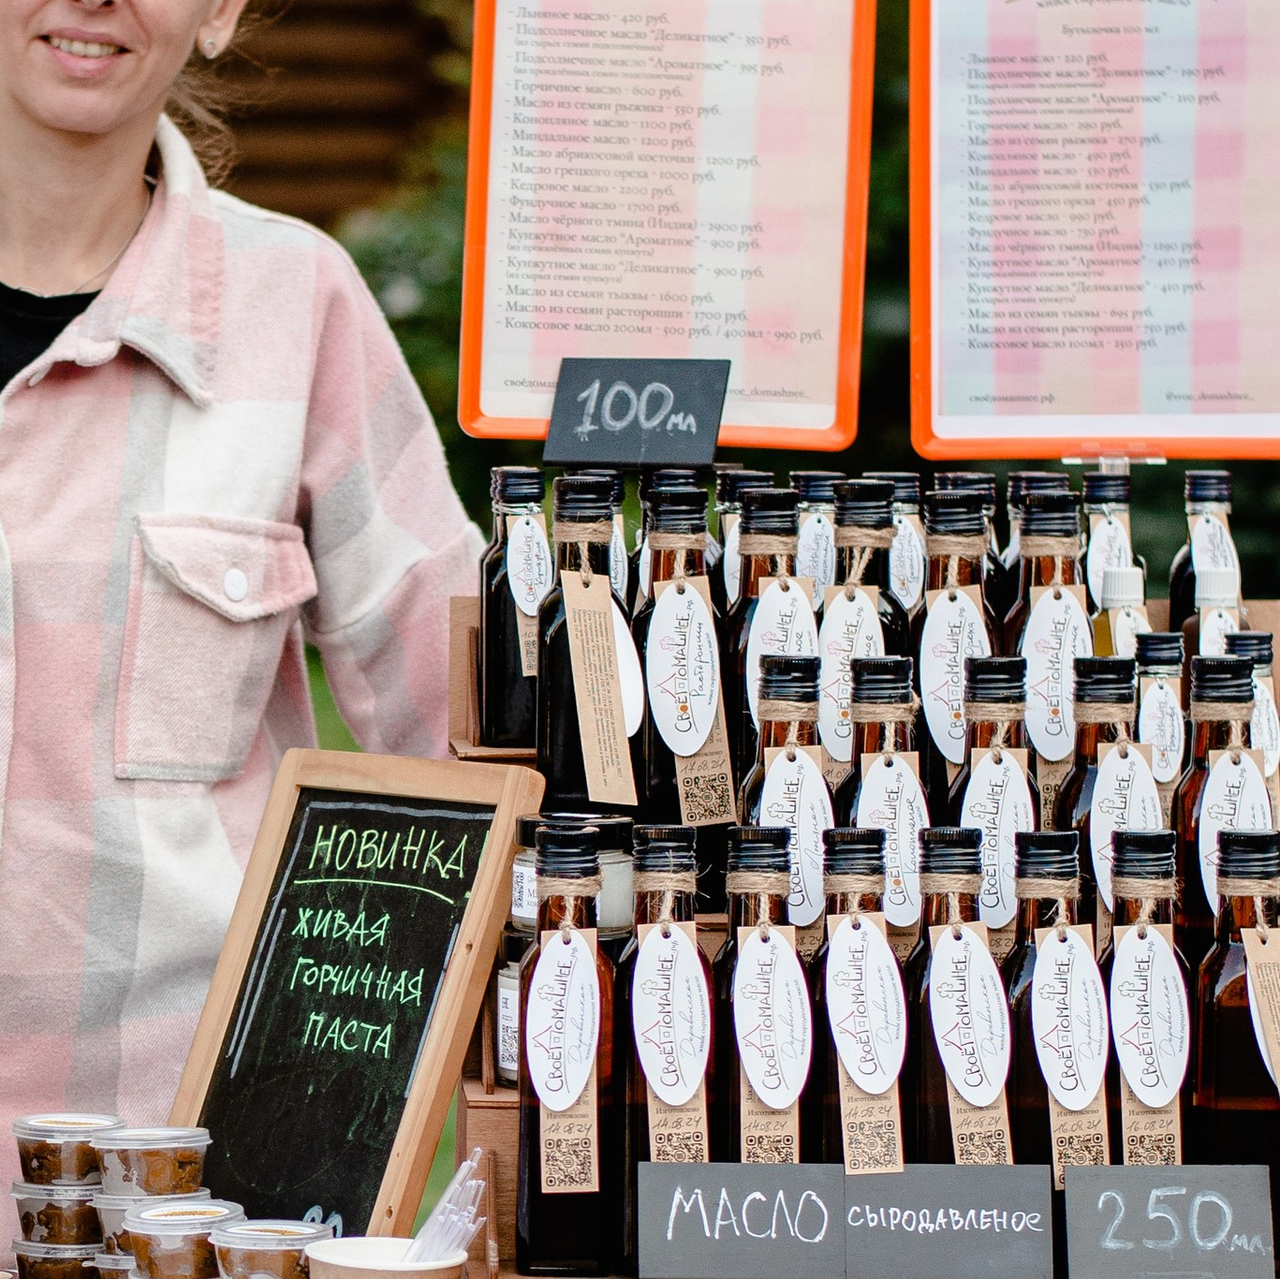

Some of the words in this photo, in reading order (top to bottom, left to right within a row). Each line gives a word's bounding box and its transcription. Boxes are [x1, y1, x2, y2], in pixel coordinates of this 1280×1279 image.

[516, 7, 570, 21] Льняное
[573, 13, 610, 22] масло
[621, 15, 643, 25] 420
[645, 13, 670, 27] руб.
[515, 23, 607, 38] Подсолнечное
[609, 30, 647, 40] масло
[766, 34, 791, 49] руб.
[512, 129, 590, 143] Миндальное
[593, 135, 630, 145] масло
[641, 137, 668, 147] 1200
[671, 136, 696, 150] руб.
[511, 145, 552, 158] Масло
[555, 147, 635, 162] абрикосовой
[637, 153, 695, 164] косточки
[705, 157, 734, 166] 1200
[736, 156, 761, 169] руб.
[506, 284, 547, 297] Масло
[549, 289, 564, 297] из
[566, 290, 604, 299] семян
[606, 291, 648, 301] тыквы
[659, 293, 688, 302] 1600
[690, 292, 715, 307] руб.
[505, 317, 570, 330] Кокосовое
[574, 323, 610, 332] масло
[688, 326, 713, 340] руб.
[800, 330, 825, 344] руб.
[292, 906, 391, 948] ЖИВАЯ
[290, 957, 424, 1006] ГОРЧИЧНАЯ
[304, 1012, 394, 1059] ПАСТА
[666, 1187, 829, 1244] МАСЛО
